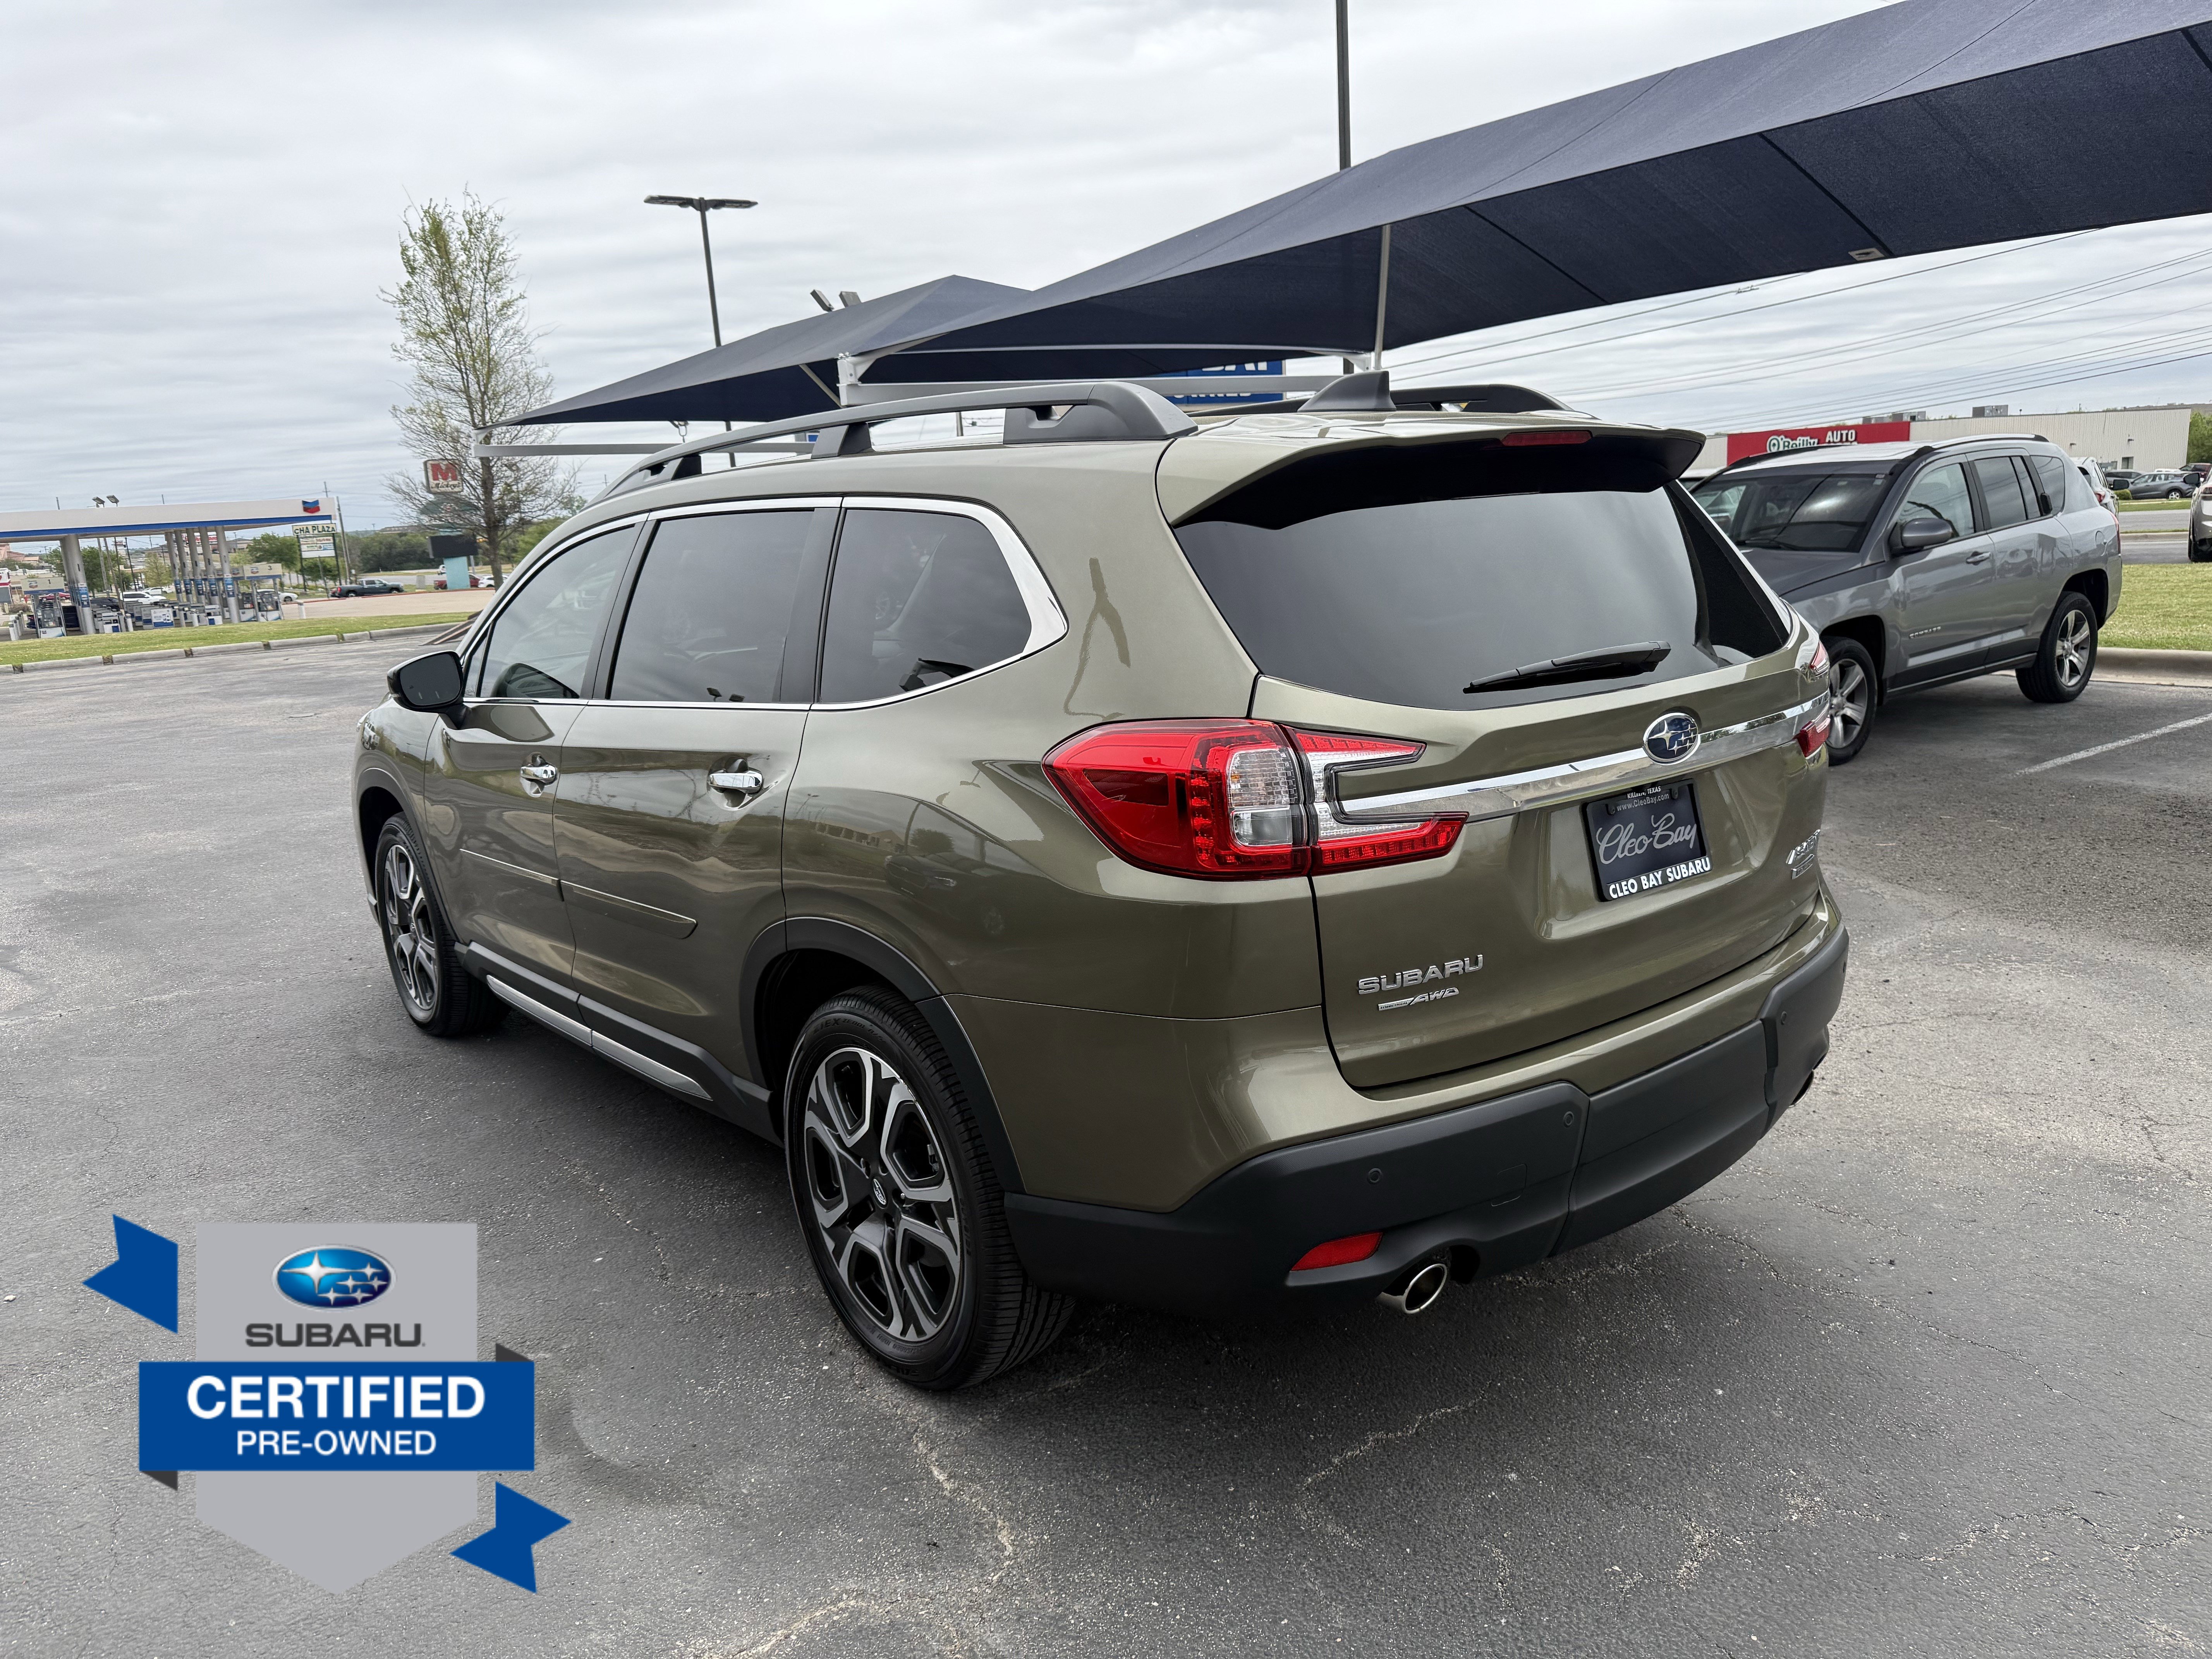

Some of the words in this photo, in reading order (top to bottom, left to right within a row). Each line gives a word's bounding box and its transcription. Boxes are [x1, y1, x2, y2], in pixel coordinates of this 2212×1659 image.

[1826, 430, 1856, 442] AUTO
[431, 463, 457, 481] M
[1647, 786, 1661, 794] TEXAS
[1617, 793, 1669, 811] www.CleoBay.com
[1596, 823, 1652, 864] Cleo
[1651, 813, 1697, 849] Bay
[1609, 878, 1638, 899] CLEO
[1640, 871, 1662, 890] BAY
[1666, 857, 1711, 883] SUBARU
[1358, 954, 1483, 995] SUBARU
[1410, 987, 1459, 1005] AWD
